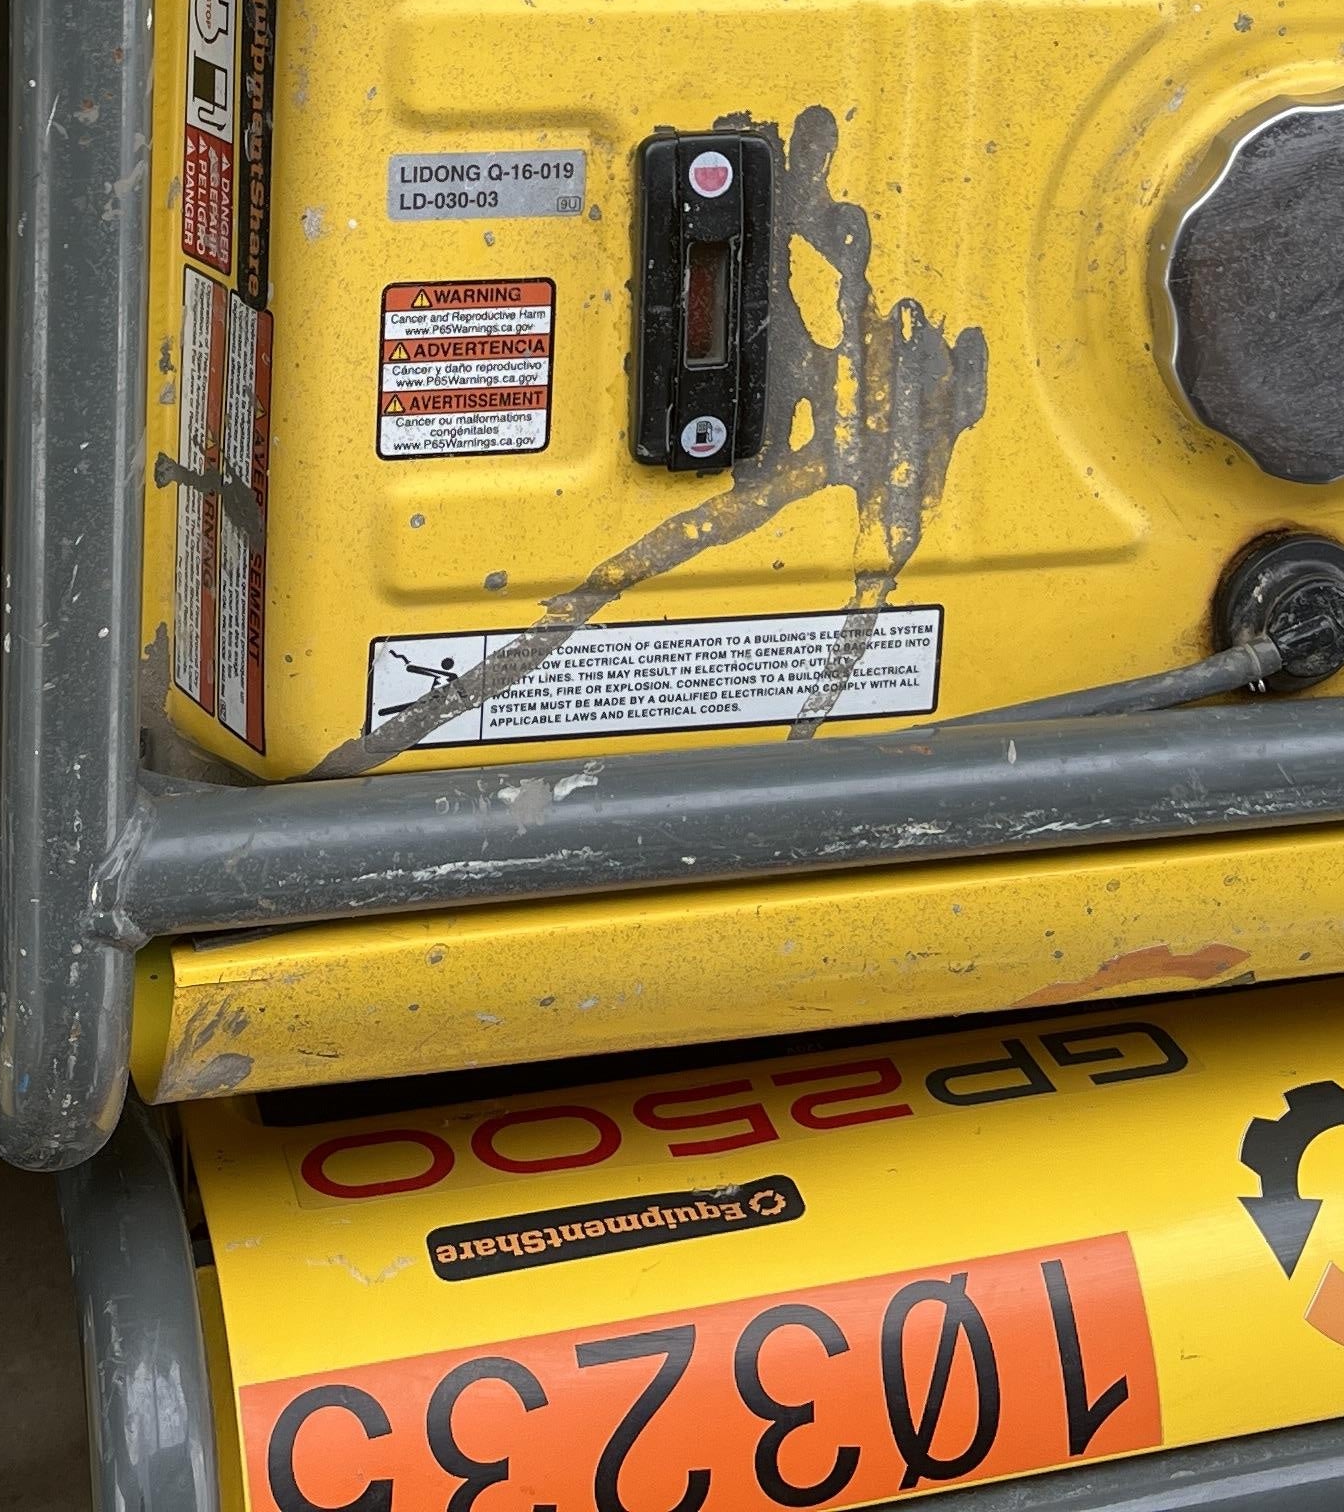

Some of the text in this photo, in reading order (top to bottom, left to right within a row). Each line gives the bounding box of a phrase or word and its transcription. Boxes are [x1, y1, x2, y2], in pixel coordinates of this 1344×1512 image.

[400, 162, 574, 184] LIDONG Q-16-019
[184, 162, 196, 246] DANGER
[196, 159, 207, 255] PELIGRO
[399, 192, 498, 210] LD-030-03
[218, 179, 230, 263] DANGER
[434, 287, 521, 304] WARNING
[391, 309, 546, 324] Cancer and Reproductive Harm
[413, 339, 545, 358] ADVERTENCIA
[392, 361, 542, 376] Cáncer y daño reproductivo
[409, 392, 543, 411] AVERTISSEMENT
[395, 412, 532, 427] Cancer ou malformations
[430, 424, 498, 439] congénitales
[490, 703, 741, 727] APPLICABLE LAWS AND ELECTRICAL CODES.
[298, 1021, 1189, 1201] GP2500
[434, 1200, 747, 1269] EquipmentShare
